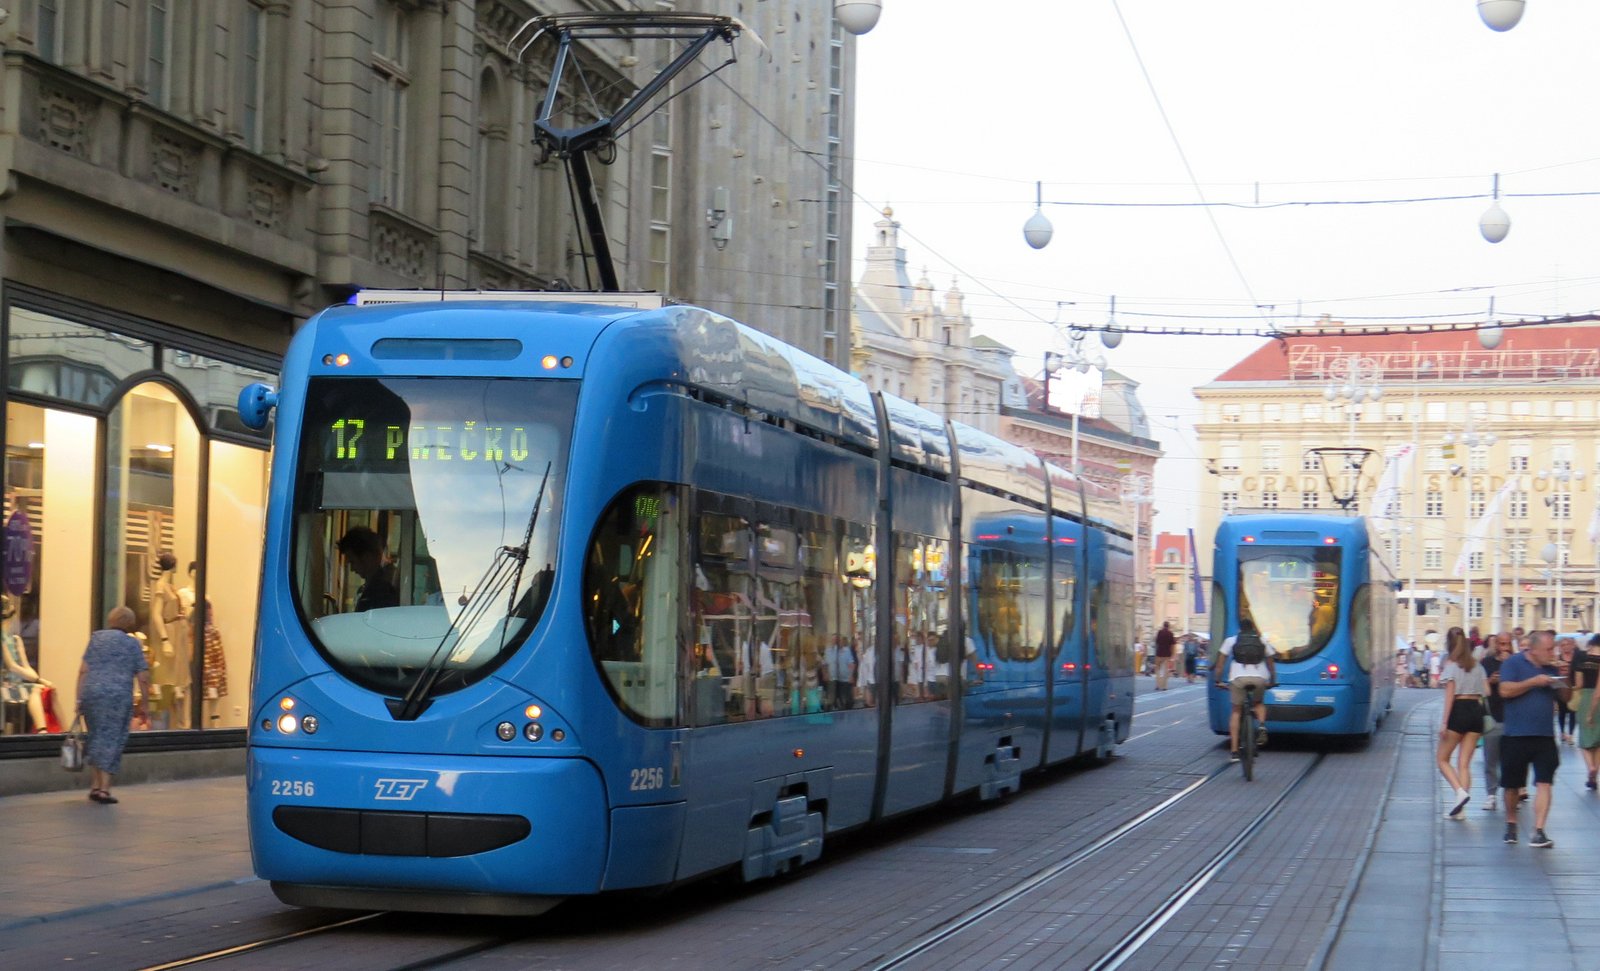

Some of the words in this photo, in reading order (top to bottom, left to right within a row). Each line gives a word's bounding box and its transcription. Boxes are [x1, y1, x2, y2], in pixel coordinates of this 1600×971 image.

[332, 419, 364, 459] 17
[271, 780, 315, 797] 2256
[374, 778, 429, 800] ZET
[631, 767, 664, 791] 2256
